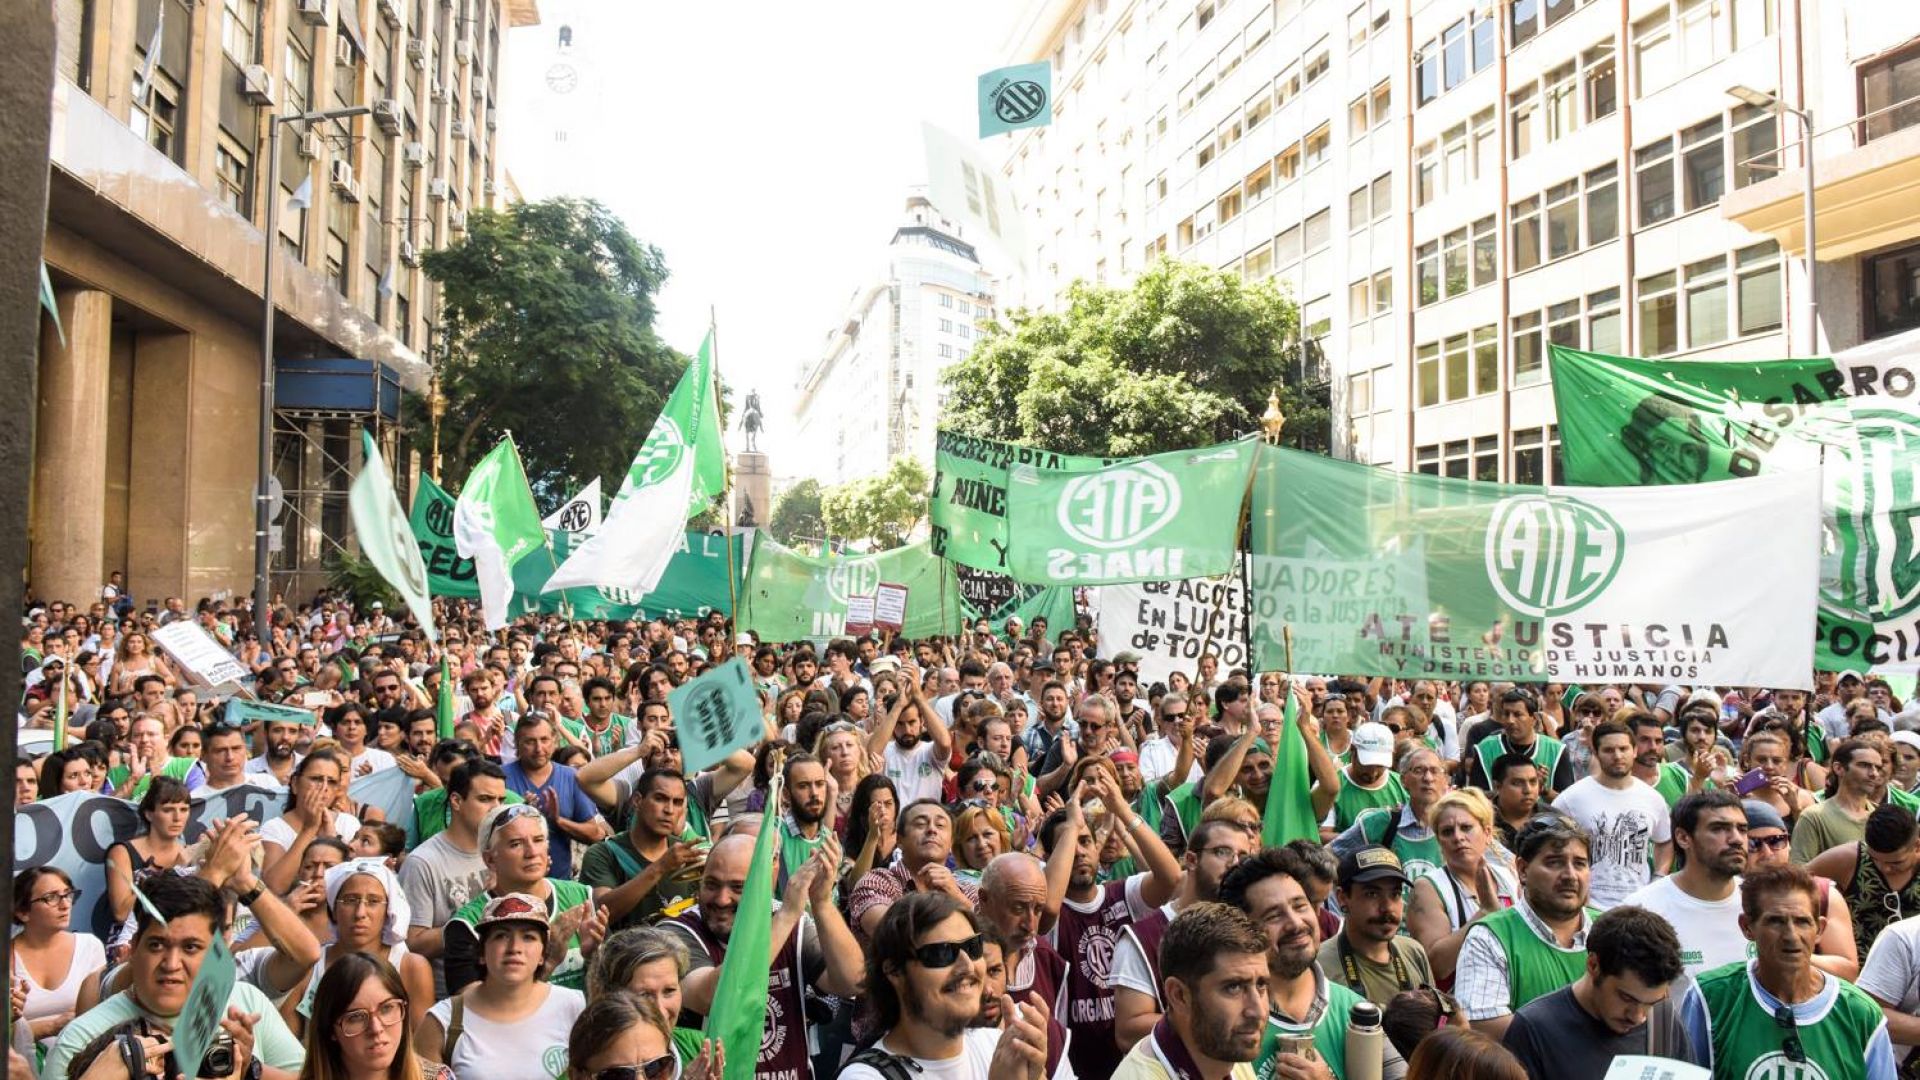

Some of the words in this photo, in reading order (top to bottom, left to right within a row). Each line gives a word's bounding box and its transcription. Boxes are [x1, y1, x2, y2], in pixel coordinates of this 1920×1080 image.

[562, 502, 588, 530] ATE
[1501, 499, 1603, 607] ATE
[832, 560, 875, 597] ATE
[1138, 599, 1166, 629] EN
[1360, 613, 1450, 643] ATE
[1131, 630, 1159, 651] de
[1379, 642, 1531, 662] MINISTERIO
[1547, 650, 1577, 662] DE
[1592, 650, 1712, 663] JUSTICIA
[1394, 659, 1407, 671] Y
[1423, 661, 1559, 677] DERECHOS
[1575, 664, 1698, 678] HUMANOS
